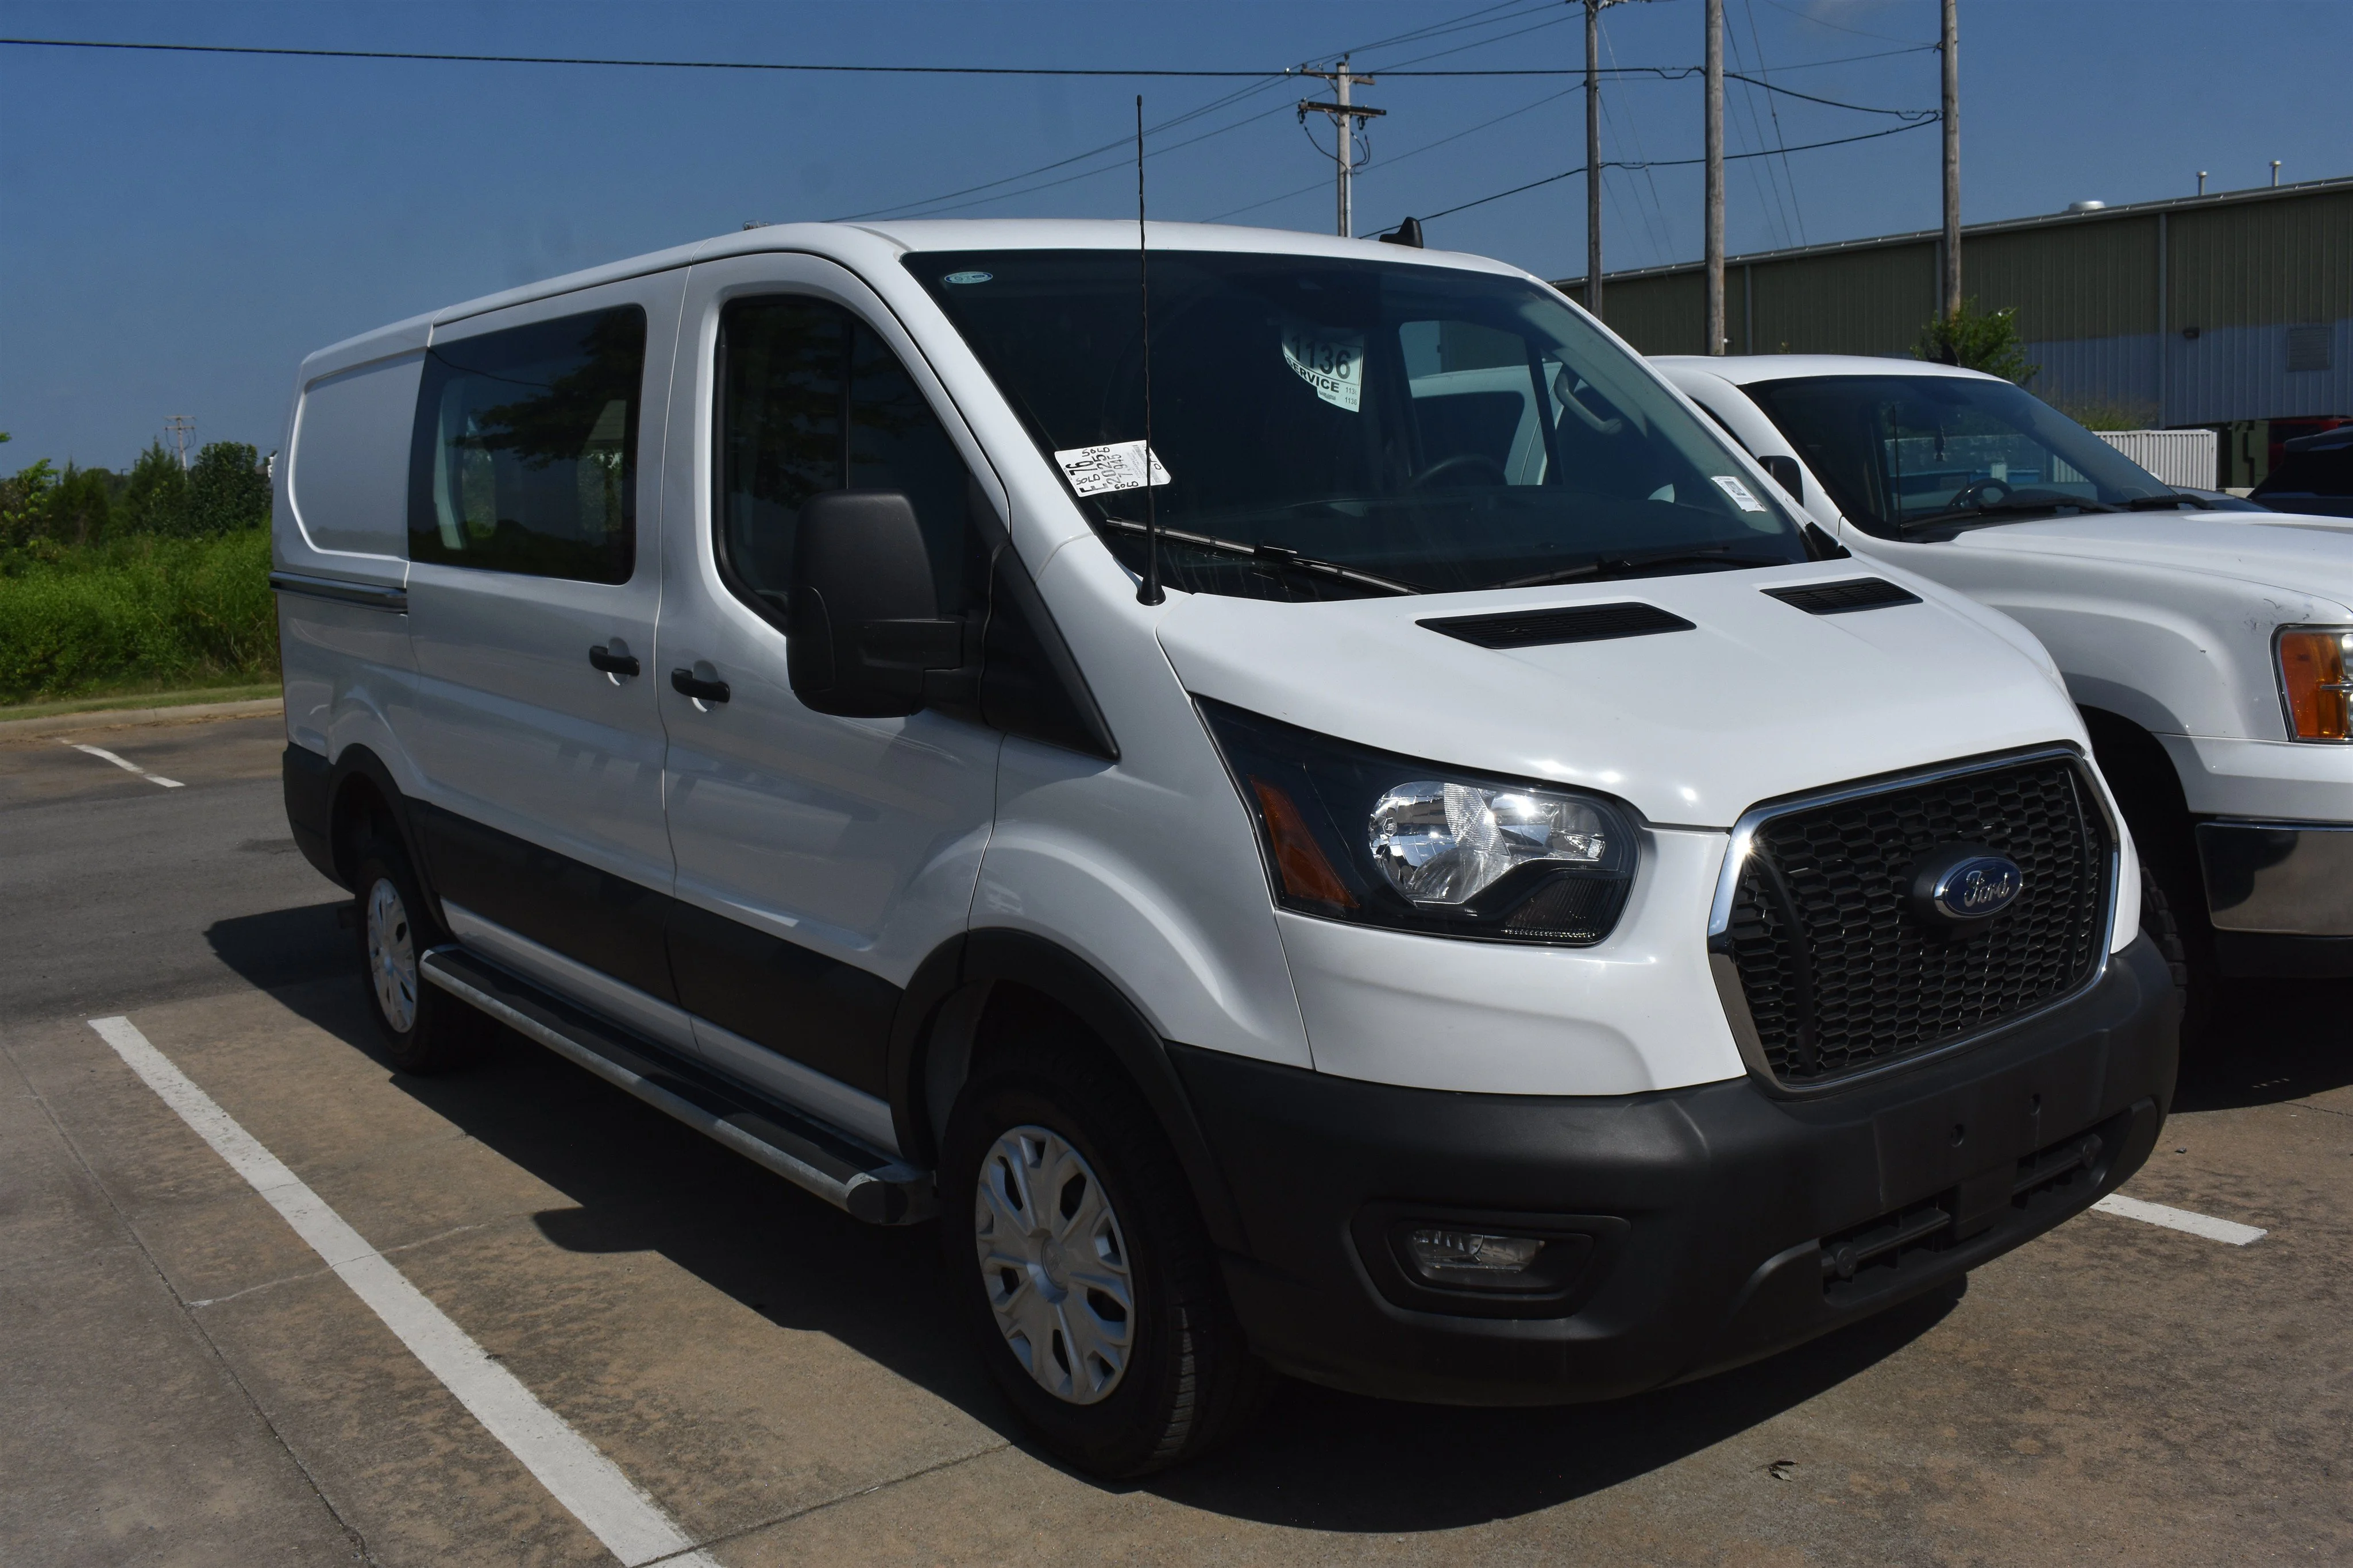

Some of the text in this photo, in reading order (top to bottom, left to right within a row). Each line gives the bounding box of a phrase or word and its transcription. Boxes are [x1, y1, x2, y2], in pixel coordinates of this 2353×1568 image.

[1291, 335, 1352, 380] 1136
[1345, 396, 1357, 405] 1136
[1082, 447, 1110, 457] SOLD
[1076, 474, 1100, 485] SOLD
[1091, 454, 1121, 485] 2025
[1964, 867, 2009, 907] Ford
